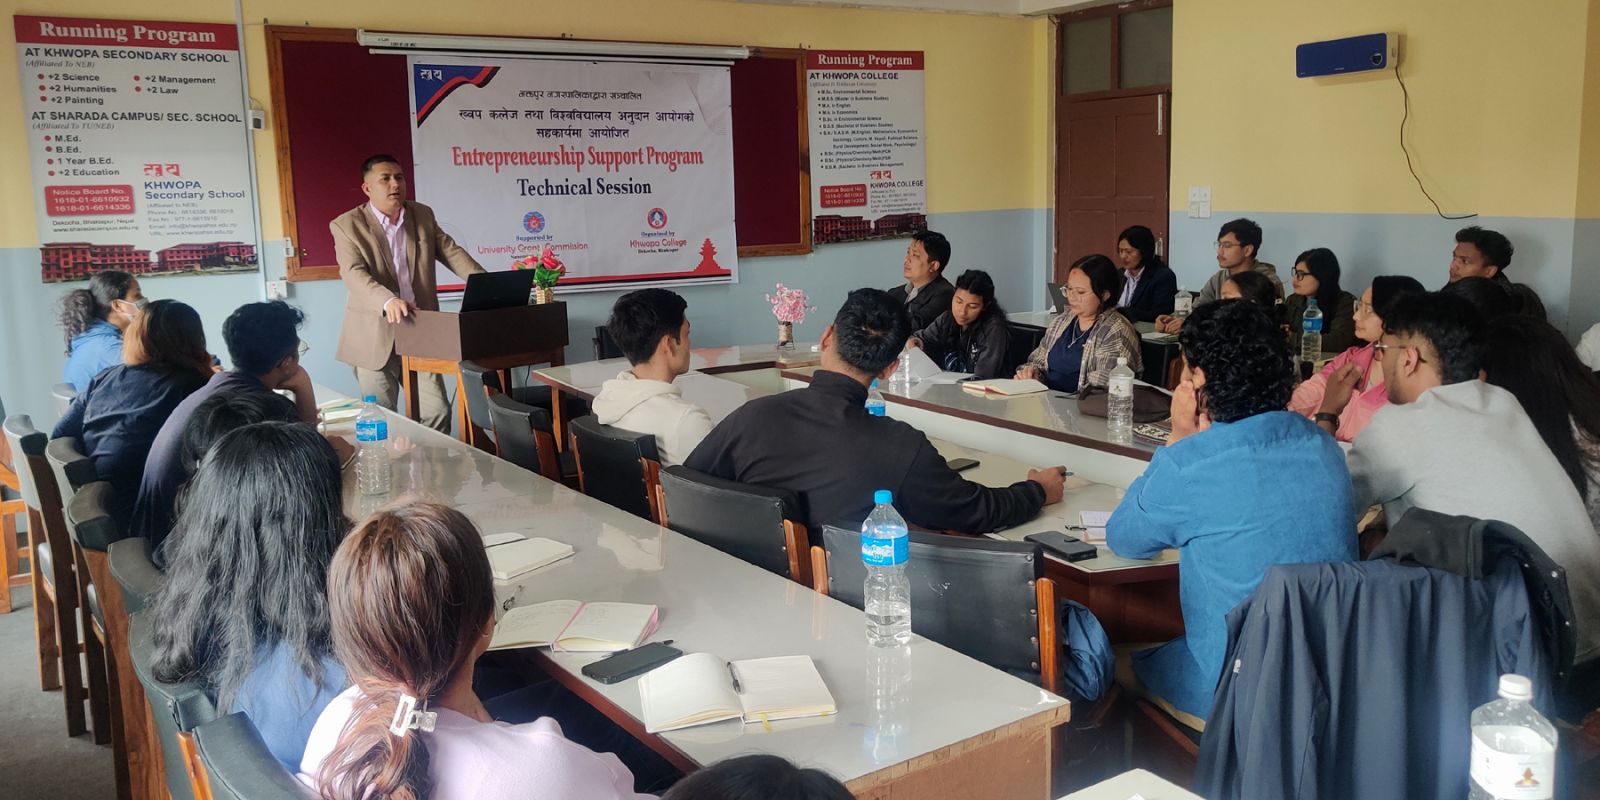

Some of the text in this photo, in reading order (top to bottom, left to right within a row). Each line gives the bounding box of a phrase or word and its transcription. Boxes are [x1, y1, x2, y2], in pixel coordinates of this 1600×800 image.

[39, 21, 216, 44] Running Program
[25, 48, 229, 62] AT KHWOPA SECONDARY SCHOOL
[818, 54, 912, 68] Running Program
[62, 73, 100, 82] Science
[158, 76, 216, 84] Management
[64, 85, 117, 93] Humanities
[64, 96, 104, 106] Painting
[32, 112, 242, 122] AT SHARADA CAMPUS/ SEC. SCHOOL
[489, 107, 518, 120] कलेज
[524, 110, 544, 120] तथा
[550, 108, 612, 122] विश्वविद्यालय
[618, 110, 650, 125] अनुदान
[656, 108, 694, 122] आयोगको
[536, 125, 630, 138] सहकार्यमा आयोजित
[66, 158, 86, 166] Year
[452, 144, 704, 173] Entrepreneurship Support Program
[144, 181, 202, 190] KHWOPA
[517, 178, 652, 196] Technical Session
[145, 190, 245, 200] Secondary School
[478, 246, 516, 254] University
[545, 242, 588, 250] Commission
[630, 238, 687, 248] Khwopa College
